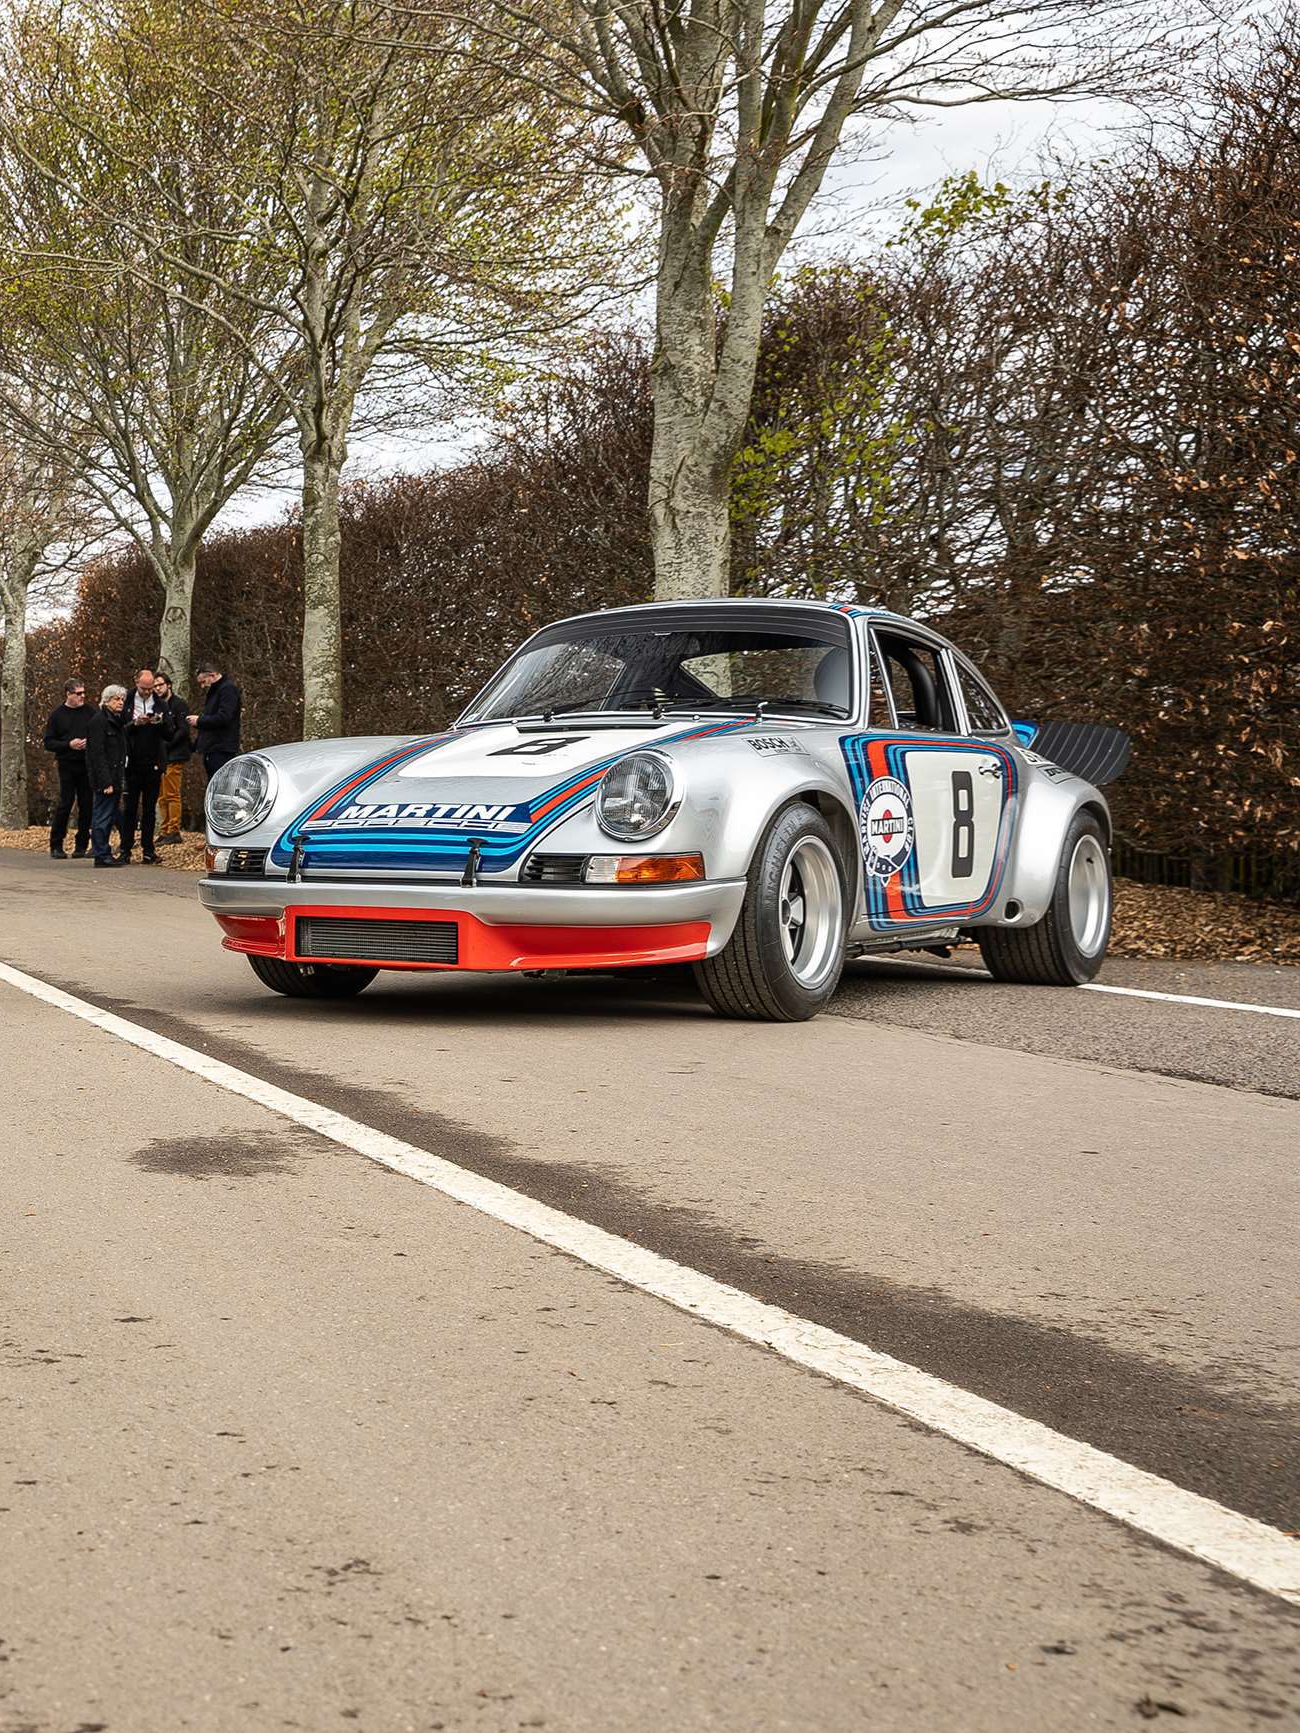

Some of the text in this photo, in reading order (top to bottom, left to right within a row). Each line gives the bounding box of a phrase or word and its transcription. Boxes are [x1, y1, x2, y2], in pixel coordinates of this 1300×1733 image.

[485, 736, 591, 756] 8
[746, 737, 790, 751] BOSCH
[337, 803, 516, 822] MARTINI
[871, 818, 904, 835] MARTINI
[952, 770, 974, 878] 8
